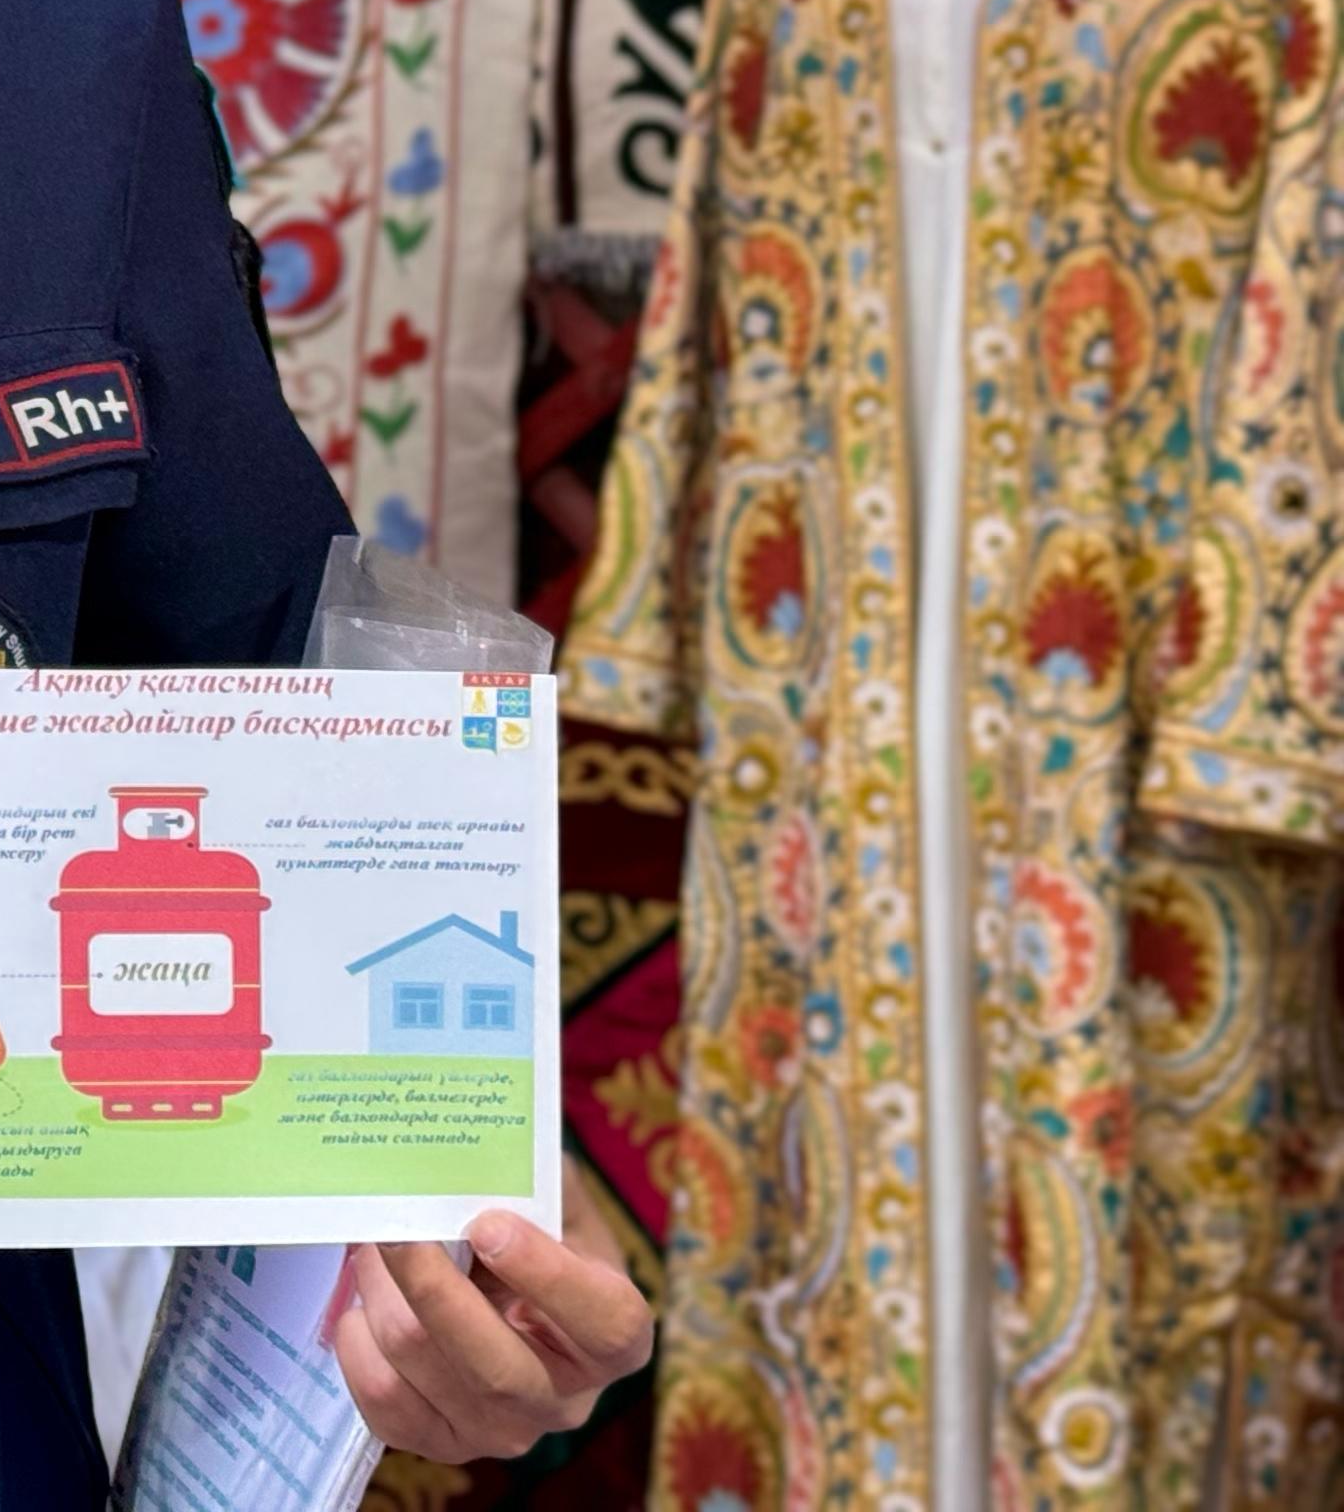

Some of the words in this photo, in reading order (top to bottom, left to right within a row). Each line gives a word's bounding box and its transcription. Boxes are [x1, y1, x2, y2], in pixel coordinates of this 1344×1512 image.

[12, 389, 130, 448] Rh+
[16, 668, 131, 699] Ақтау
[138, 671, 335, 700] қаласының
[243, 709, 453, 742] басқармасы
[72, 805, 98, 820] екі
[265, 817, 292, 829] газ
[12, 826, 37, 843] бір
[40, 828, 76, 843] рет
[434, 860, 522, 876] толтыру
[112, 959, 213, 987] жаңа
[329, 1110, 438, 1127] балкондарда
[321, 1132, 388, 1145] тыйым
[392, 1131, 481, 1145] салынады
